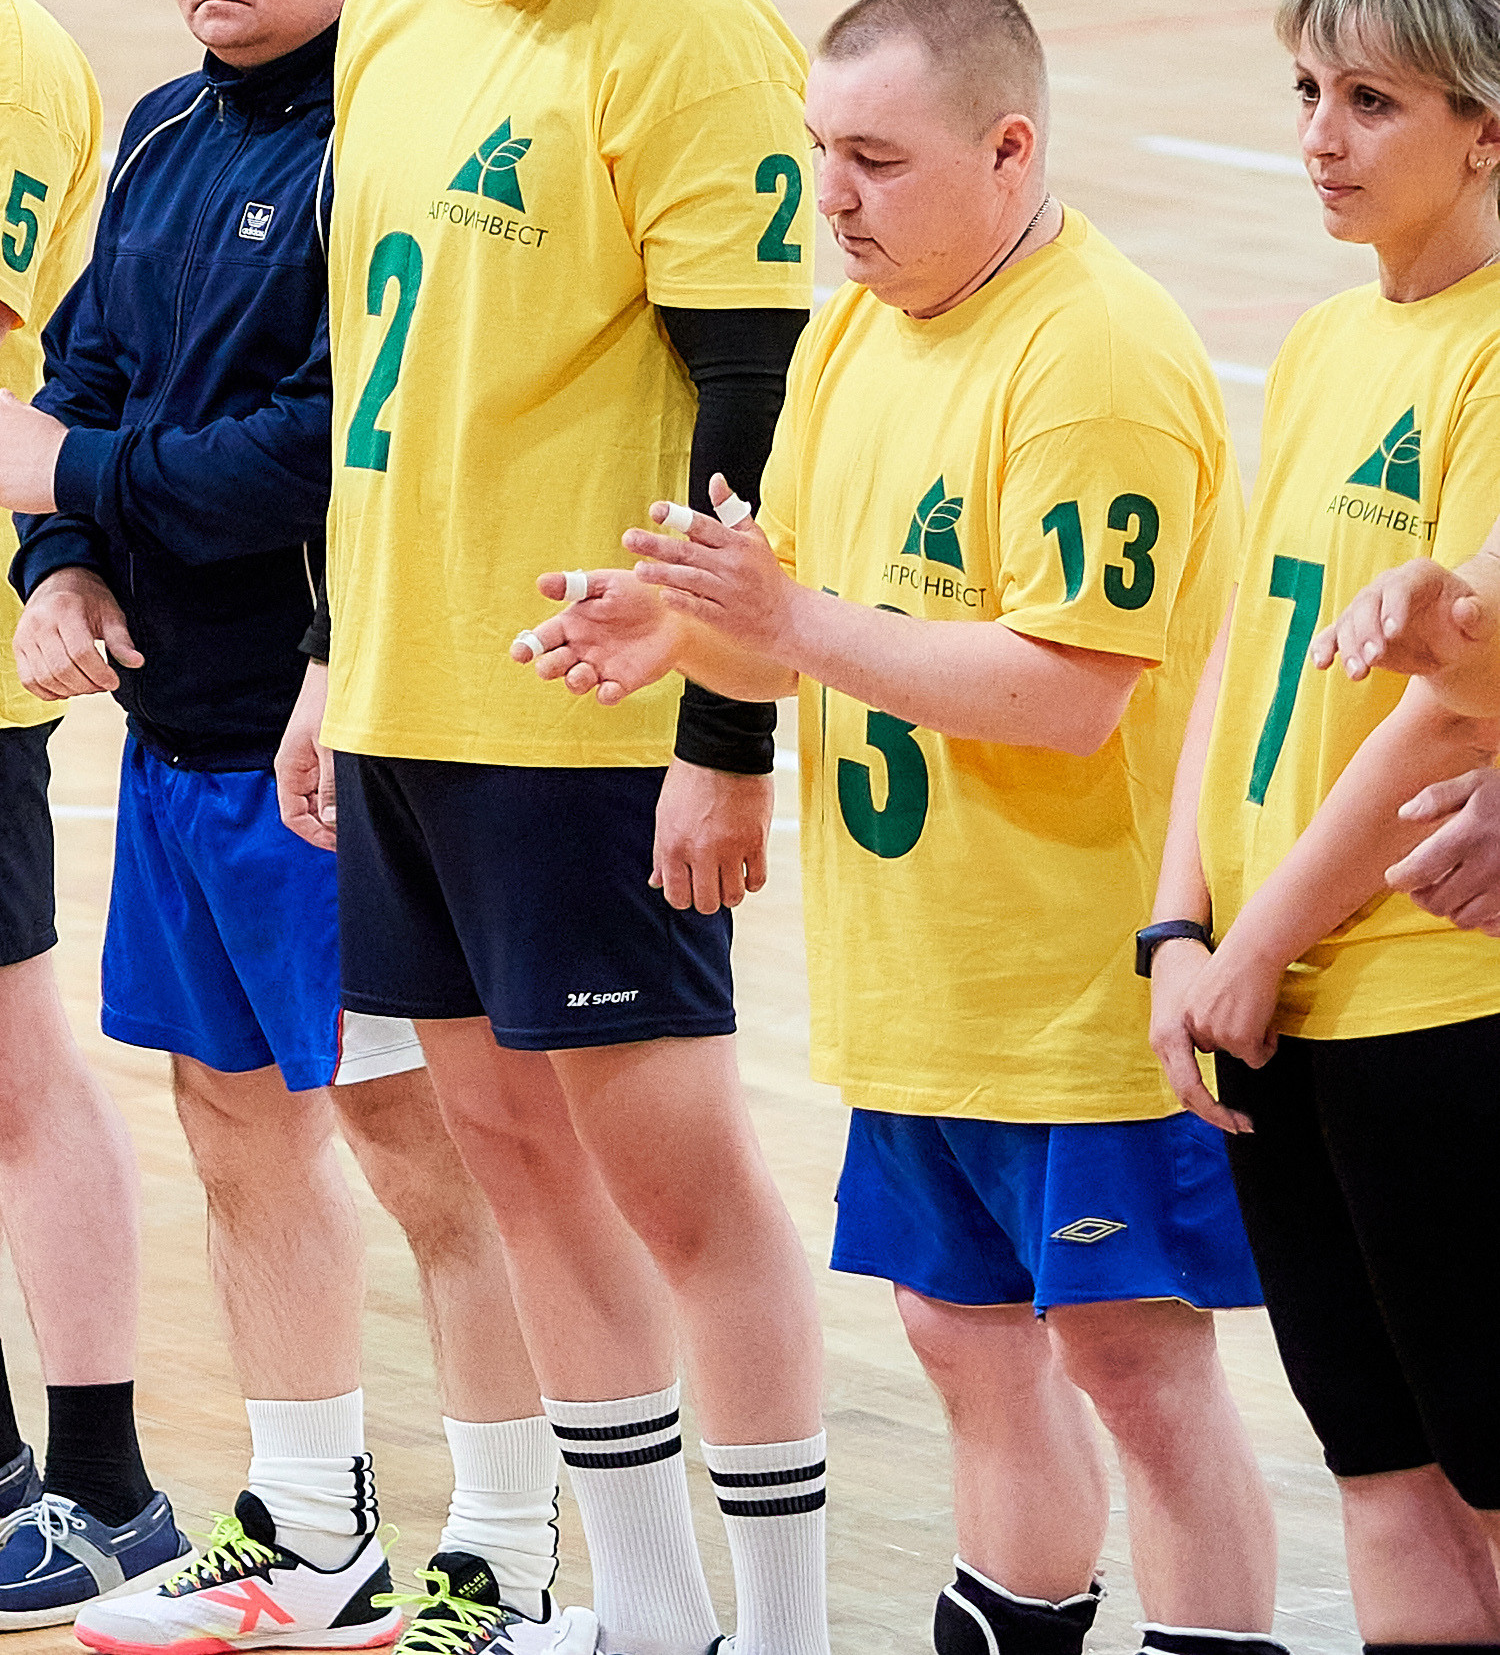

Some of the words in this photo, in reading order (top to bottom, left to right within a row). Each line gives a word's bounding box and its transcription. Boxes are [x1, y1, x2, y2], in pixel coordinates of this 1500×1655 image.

[427, 200, 549, 248] АГРОИНВЕСТ
[755, 153, 802, 263] 2
[344, 231, 424, 473] 2
[1041, 492, 1160, 611] 13
[1245, 553, 1326, 807] 7
[592, 990, 639, 1005] SPORT
